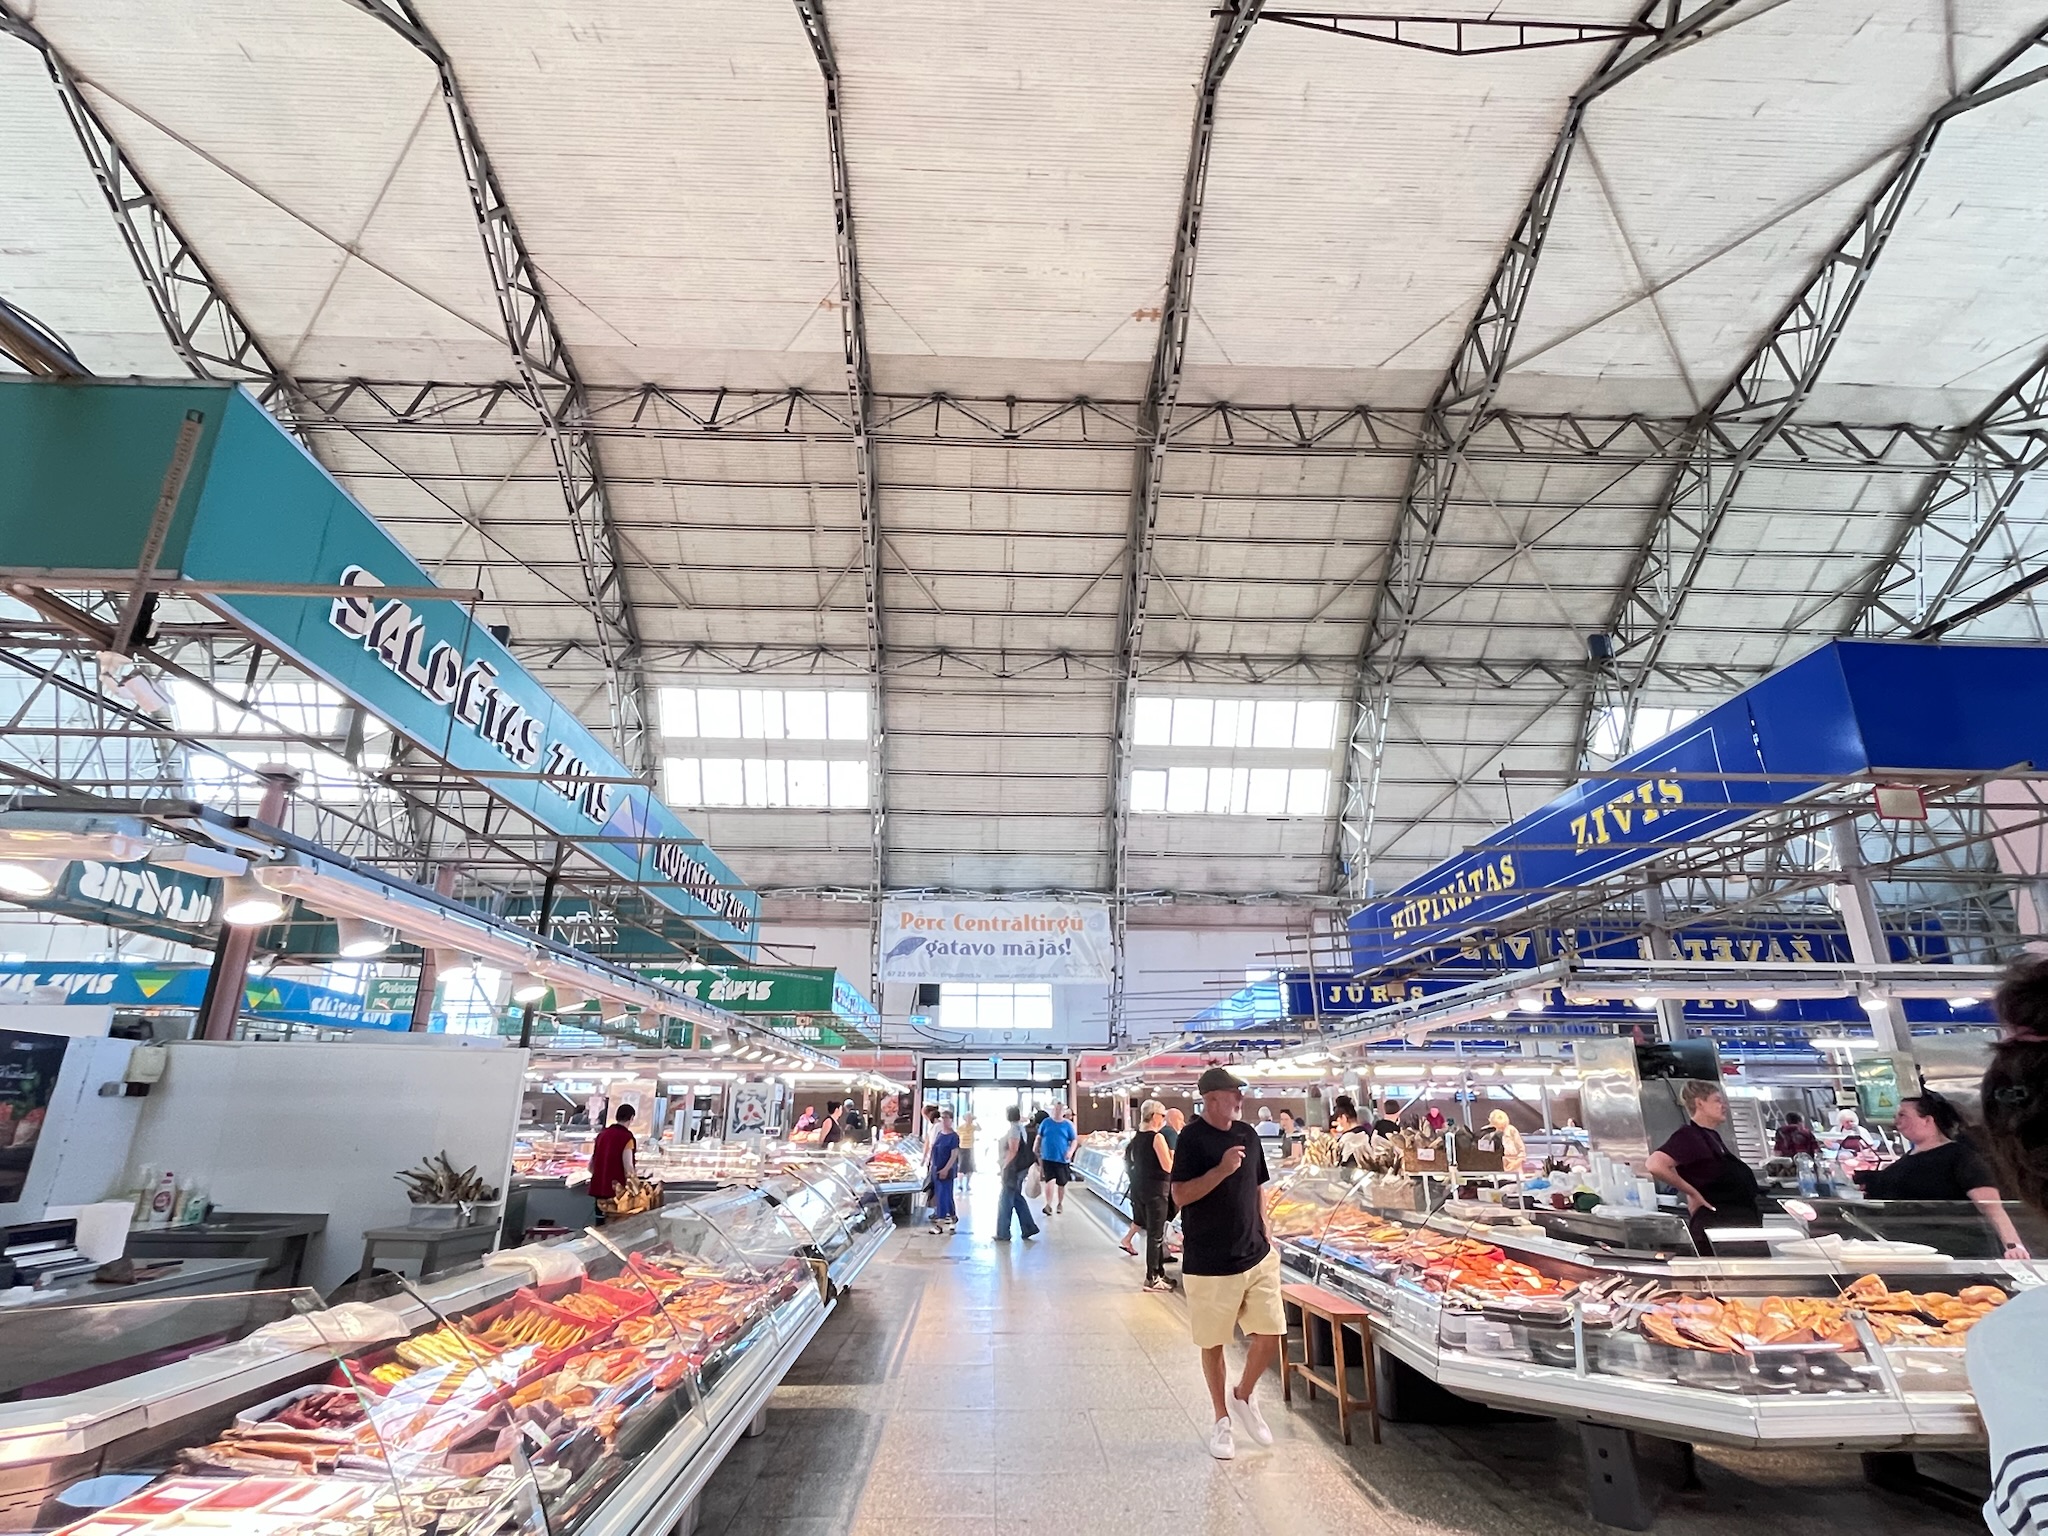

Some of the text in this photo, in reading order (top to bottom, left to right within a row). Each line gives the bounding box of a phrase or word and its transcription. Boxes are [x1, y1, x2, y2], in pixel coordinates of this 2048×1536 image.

[330, 566, 614, 825] SALDĒTAS ZIVIS
[1390, 767, 1684, 940] KŪPINĀTAS ZIVIS
[900, 911, 1084, 935] Pērc Centrāltirgū
[925, 937, 1072, 959] gatavo mājās!
[1329, 983, 1424, 1003] JŪRS
